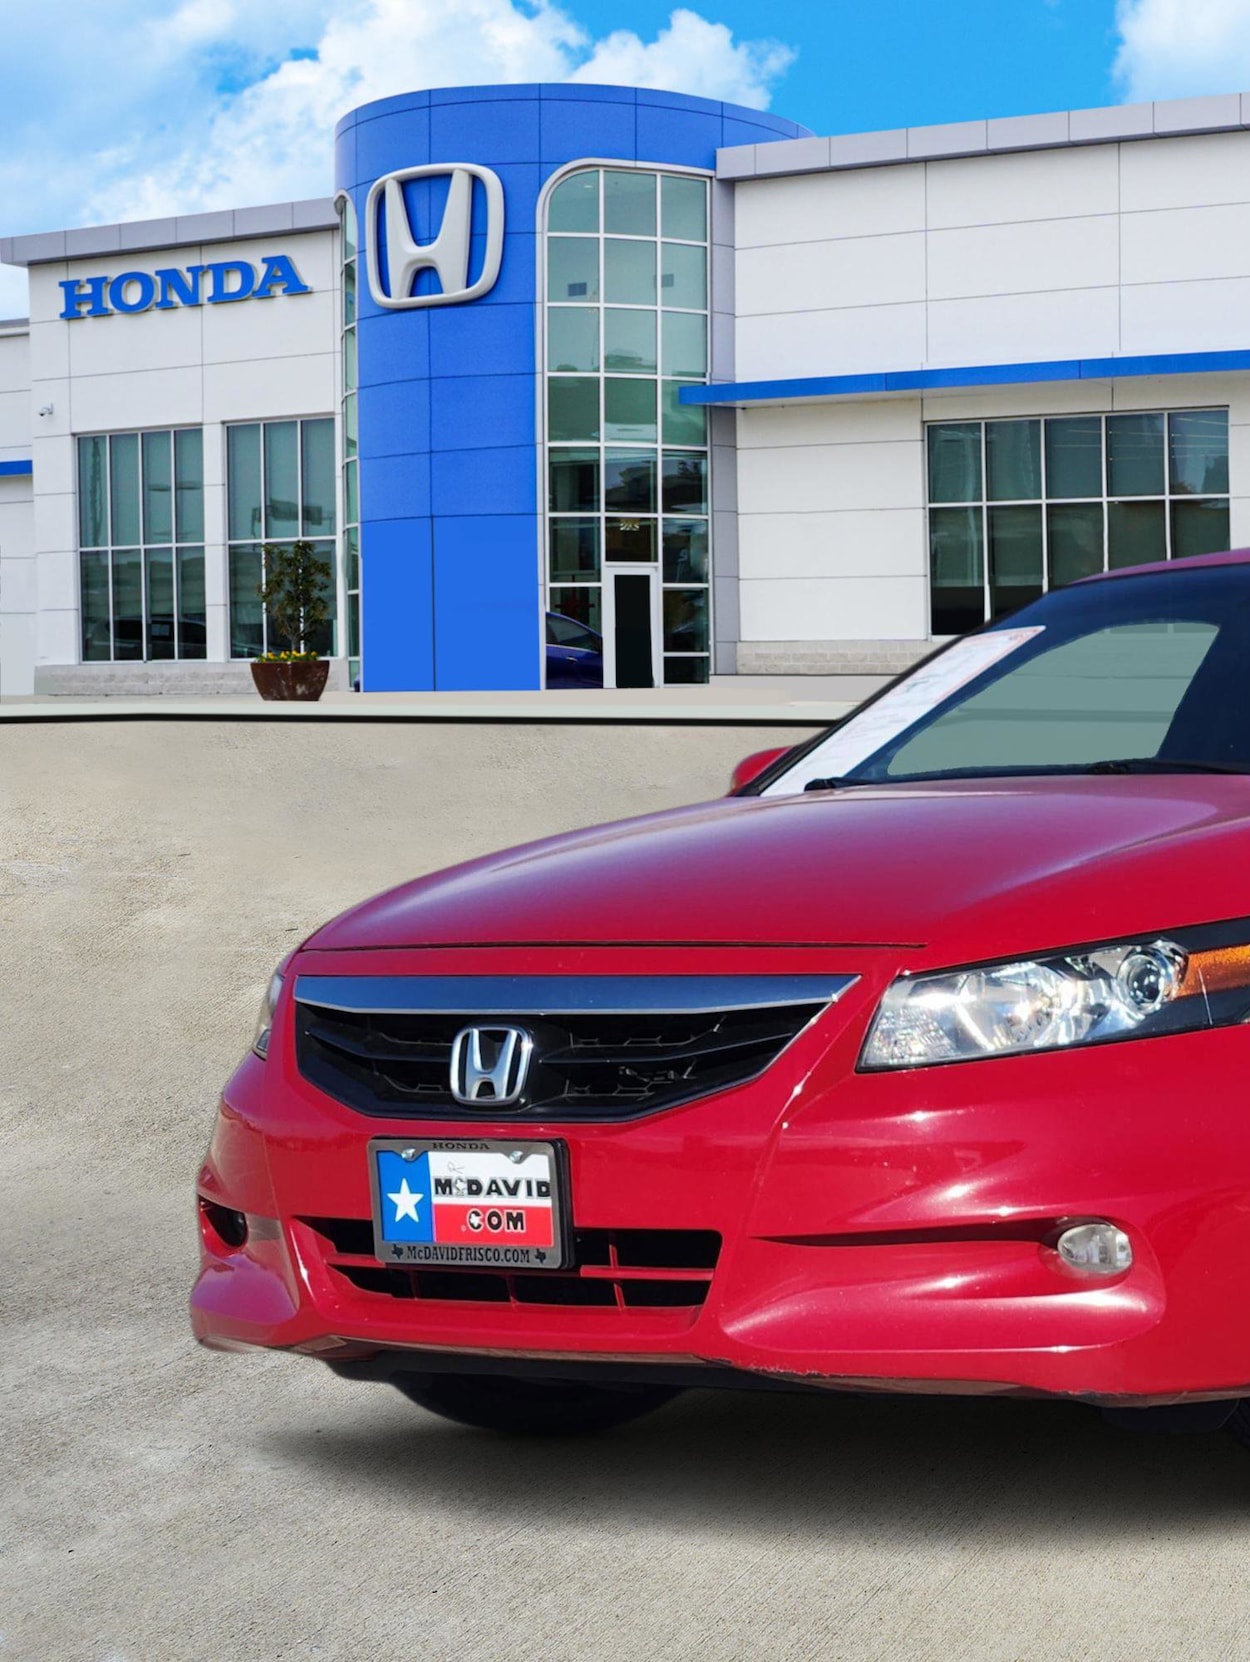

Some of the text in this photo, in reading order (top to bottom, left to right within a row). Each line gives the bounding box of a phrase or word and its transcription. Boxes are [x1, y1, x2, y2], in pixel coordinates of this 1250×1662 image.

[59, 255, 311, 319] HONDA
[432, 1141, 490, 1150] HONDA
[406, 1246, 530, 1263] McDAVIDFRISCO.COM
